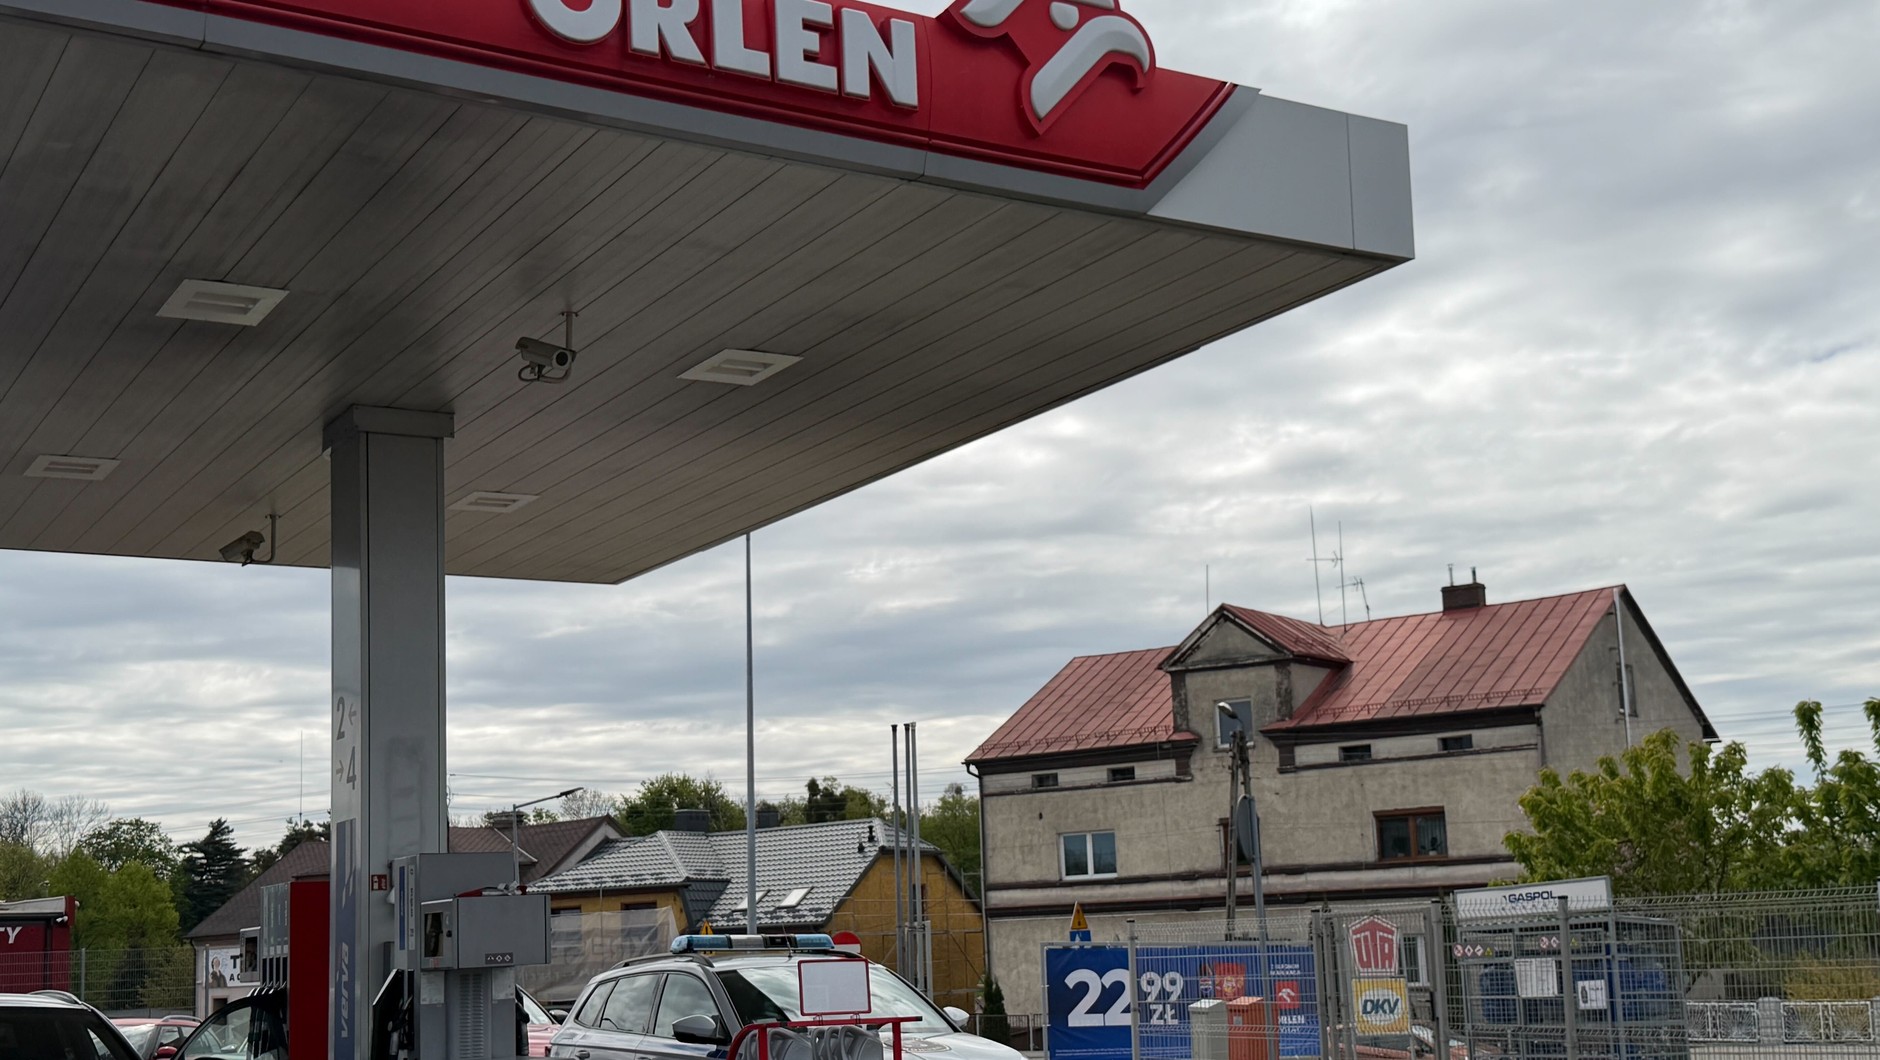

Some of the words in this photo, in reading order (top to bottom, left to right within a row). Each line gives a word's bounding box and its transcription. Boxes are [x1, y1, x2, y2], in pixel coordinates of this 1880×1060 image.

[337, 696, 345, 740] 2
[346, 746, 356, 790] 4
[1508, 890, 1557, 903] GASPOL
[1352, 920, 1397, 970] UTA
[341, 942, 349, 1037] verva
[1064, 968, 1132, 1027] 22
[1140, 971, 1184, 1002] 99
[1362, 998, 1400, 1015] DKV
